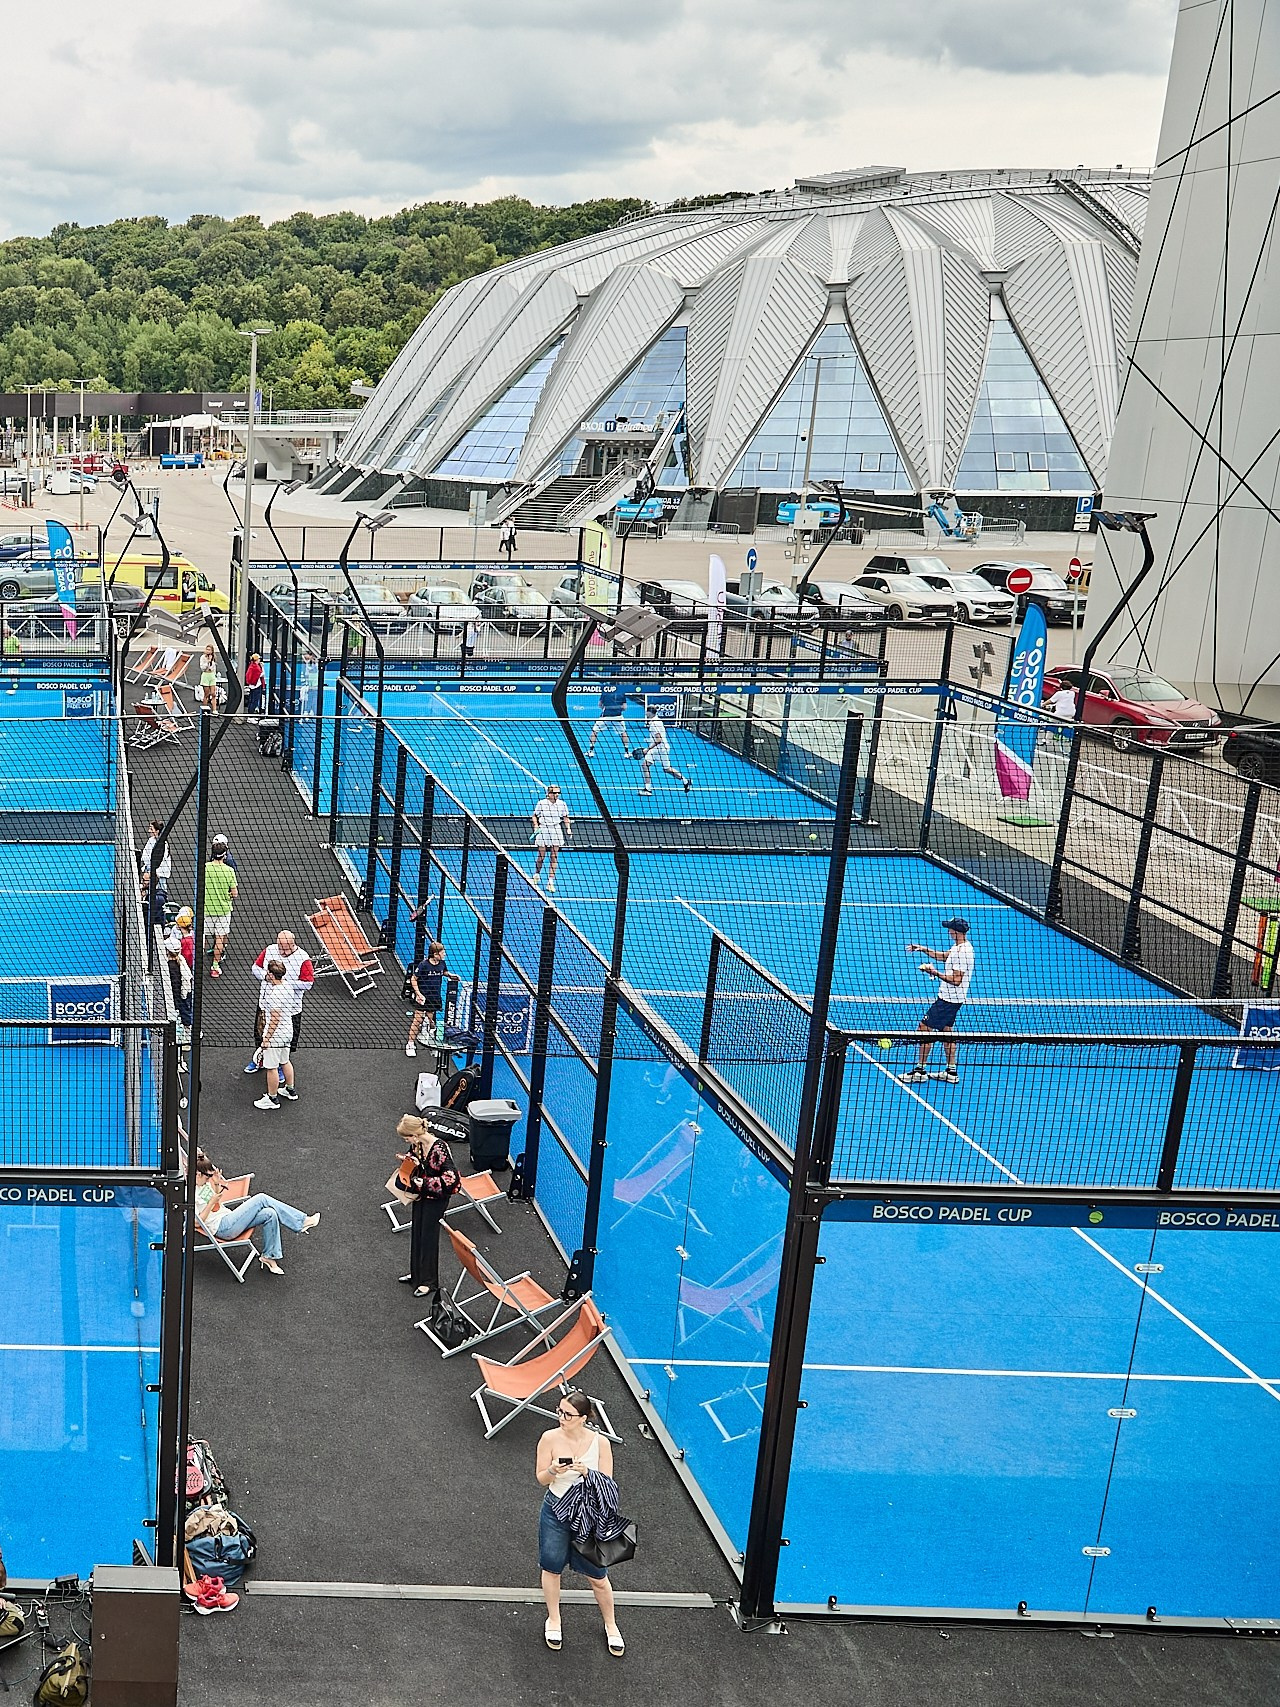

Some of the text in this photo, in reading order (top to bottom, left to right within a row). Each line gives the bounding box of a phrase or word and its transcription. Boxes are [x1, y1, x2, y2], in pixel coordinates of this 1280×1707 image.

[1081, 498, 1090, 512] P
[56, 1002, 106, 1014] BOSCO
[1249, 1026, 1280, 1037] BOS
[428, 1121, 466, 1139] HEAD
[27, 1188, 78, 1202] PADEL
[82, 1189, 115, 1203] CUP
[872, 1206, 1032, 1222] BOSCO PADEL CUP
[1159, 1211, 1280, 1227] BOSCO PADEL
